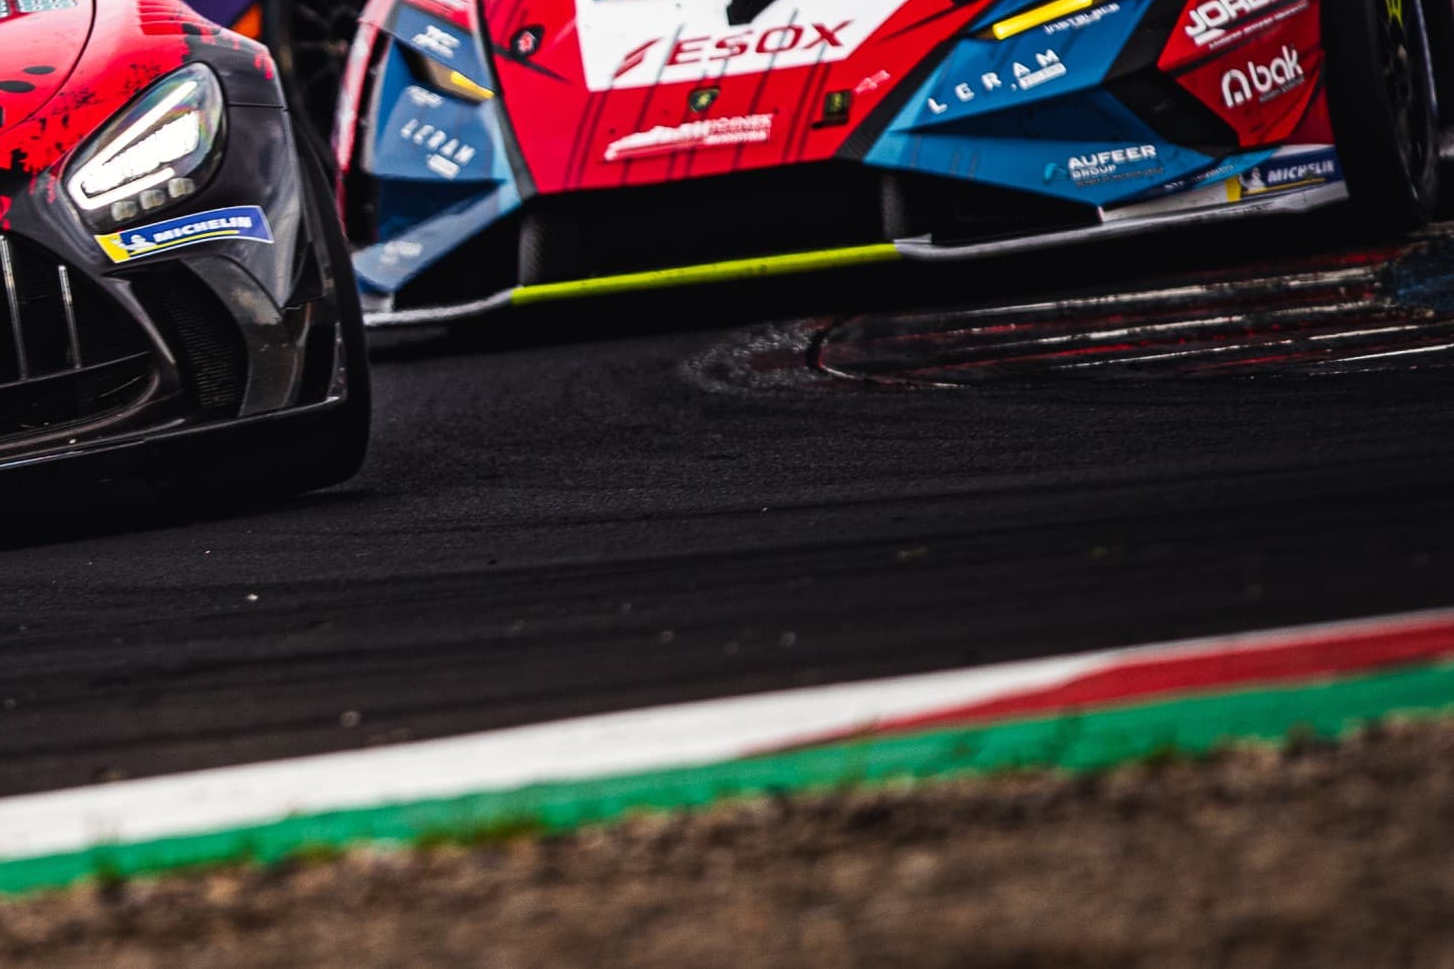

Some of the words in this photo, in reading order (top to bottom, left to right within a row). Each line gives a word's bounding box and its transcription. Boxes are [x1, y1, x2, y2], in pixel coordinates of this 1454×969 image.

[666, 19, 854, 66] ESOX
[1068, 144, 1157, 169] AUFEER
[1072, 164, 1117, 179] GROUP
[152, 216, 253, 243] MICHELIN
